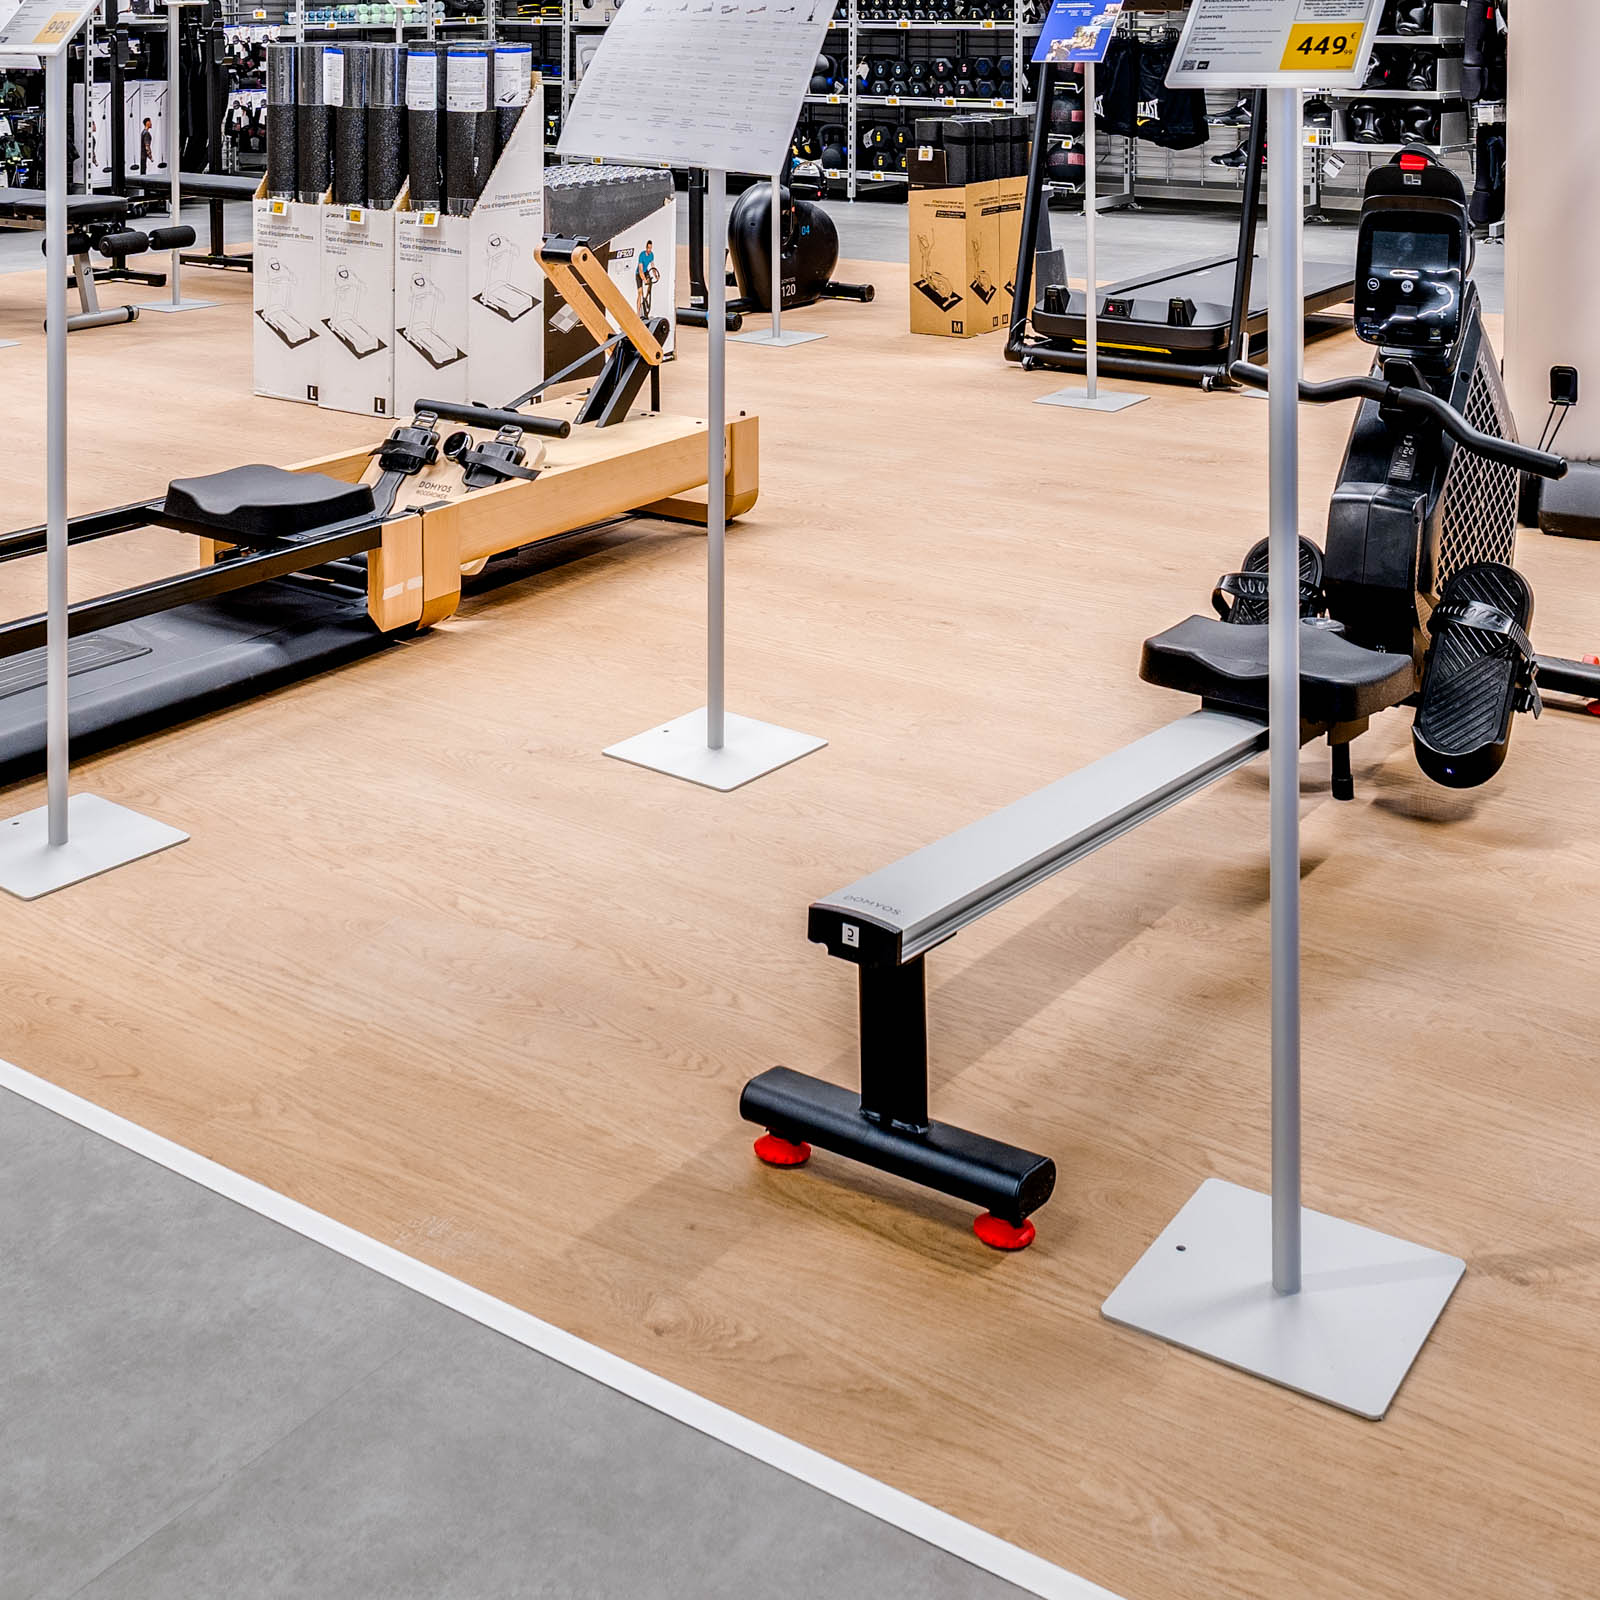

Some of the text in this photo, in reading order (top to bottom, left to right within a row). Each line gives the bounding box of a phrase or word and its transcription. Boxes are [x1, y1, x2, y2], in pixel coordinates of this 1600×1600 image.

[1296, 35, 1348, 55] 449
[1351, 31, 1357, 39] €
[953, 323, 962, 333] M
[310, 386, 316, 399] L
[377, 399, 384, 412] L
[419, 481, 452, 493] DOMYOS
